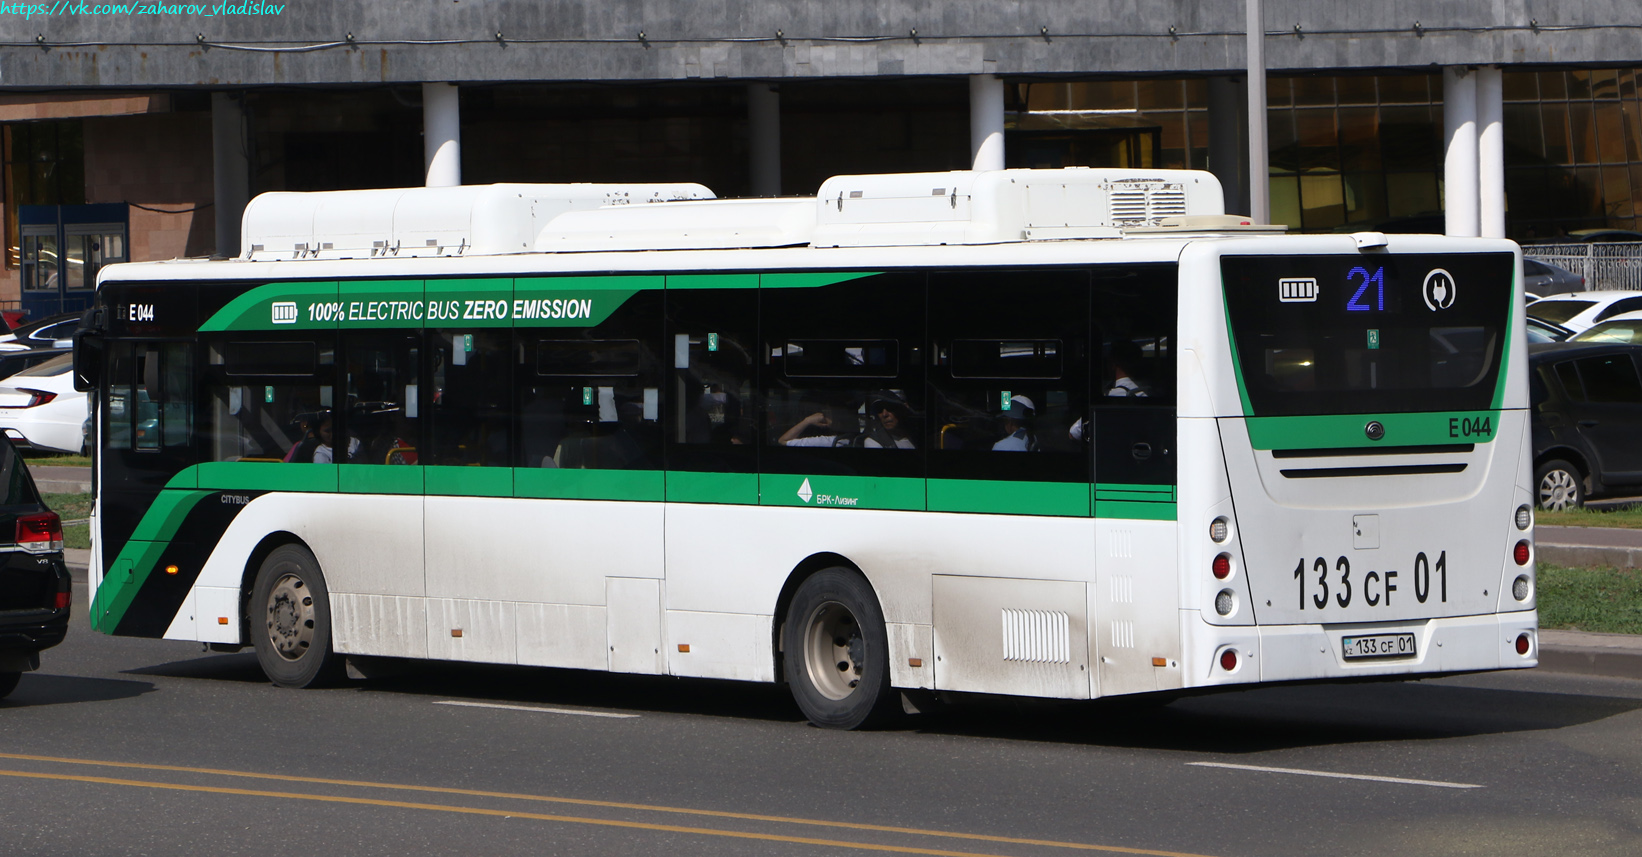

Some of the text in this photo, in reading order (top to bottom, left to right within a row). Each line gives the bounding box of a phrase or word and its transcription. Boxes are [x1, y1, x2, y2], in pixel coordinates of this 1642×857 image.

[1346, 266, 1384, 311] 21
[129, 303, 154, 321] E 044
[308, 299, 592, 321] 100% ELECTRIC BUS ZERO EMISSION
[1449, 416, 1492, 438] E 044
[220, 494, 250, 505] CITYBUS
[816, 494, 859, 506] БРК-Лизинг
[1294, 550, 1447, 611] 133 CF 01
[1355, 636, 1413, 655] 133 CF 01
